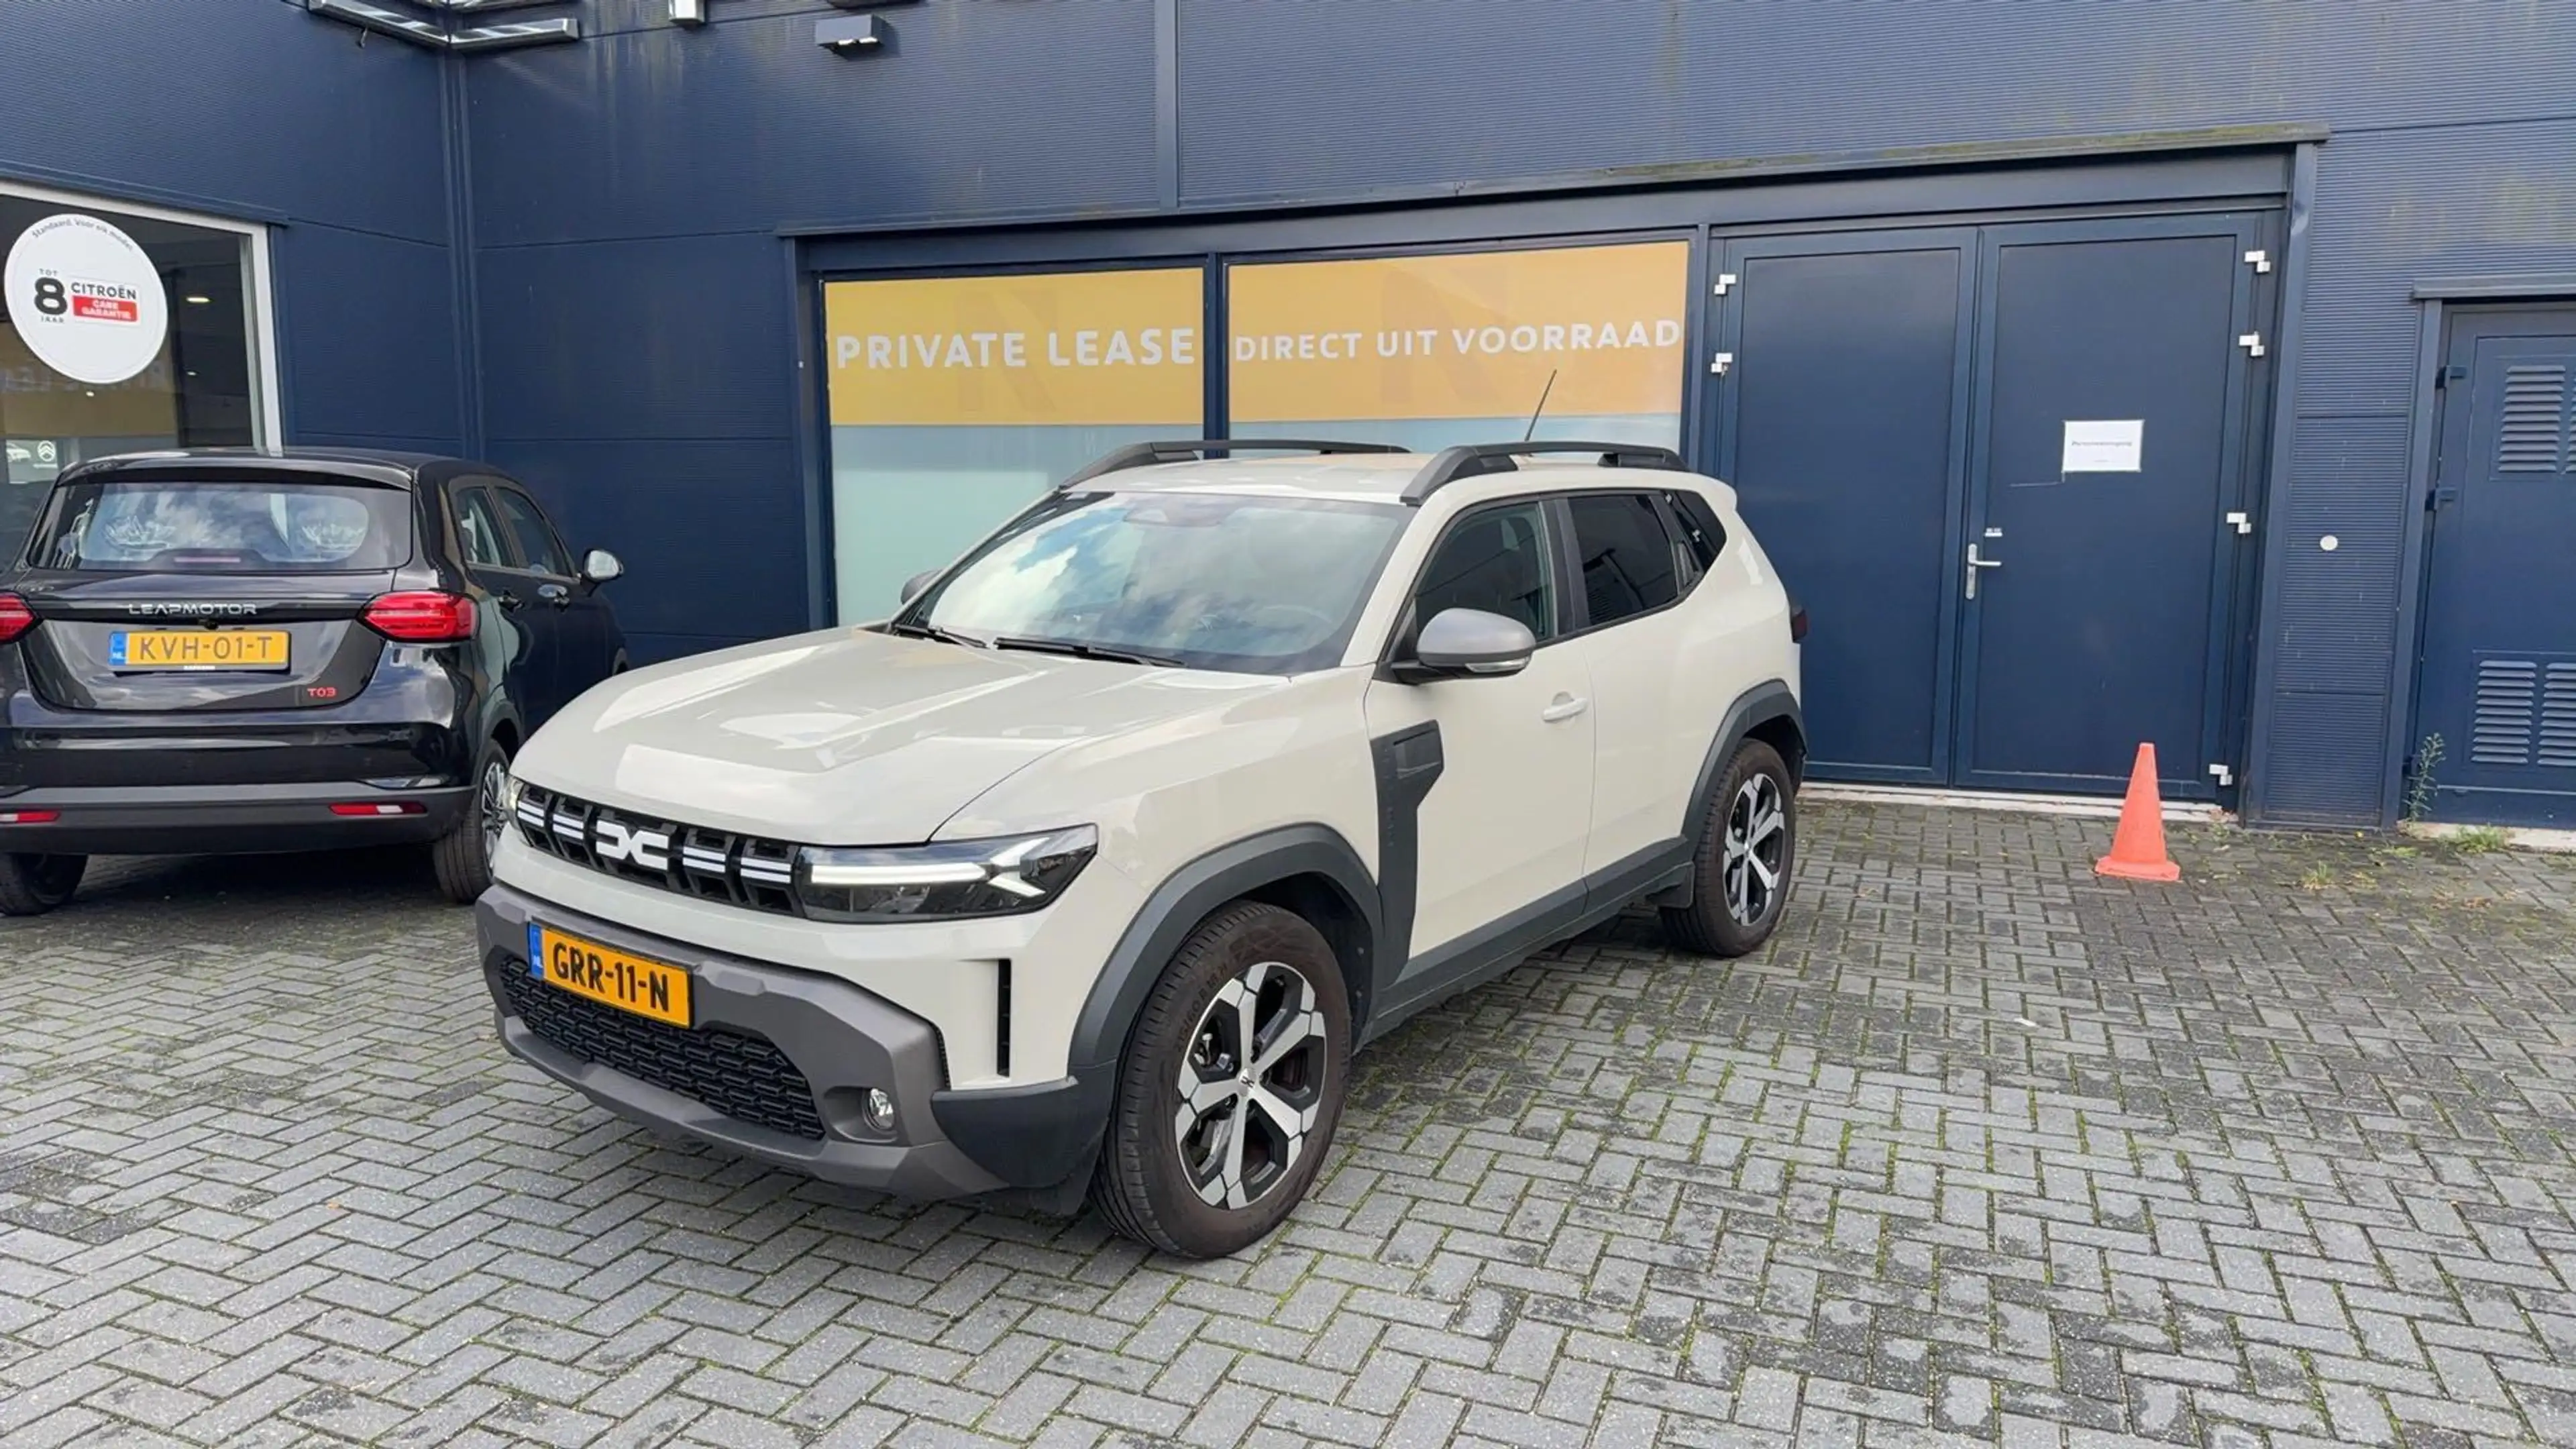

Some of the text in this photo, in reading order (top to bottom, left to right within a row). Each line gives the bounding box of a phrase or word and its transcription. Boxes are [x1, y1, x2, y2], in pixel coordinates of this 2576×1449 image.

[39, 268, 58, 276] TOT
[34, 277, 68, 315] 8
[71, 282, 137, 299] CITROËN
[836, 328, 1195, 369] PRIVATE LEASE
[1235, 319, 1680, 362] DIRECT UIT VOORRAAD
[128, 603, 258, 616] LEAPMOTOR
[140, 635, 273, 660] KVH-01-T
[307, 686, 337, 698] T03
[553, 941, 669, 1013] GRR-11-N
